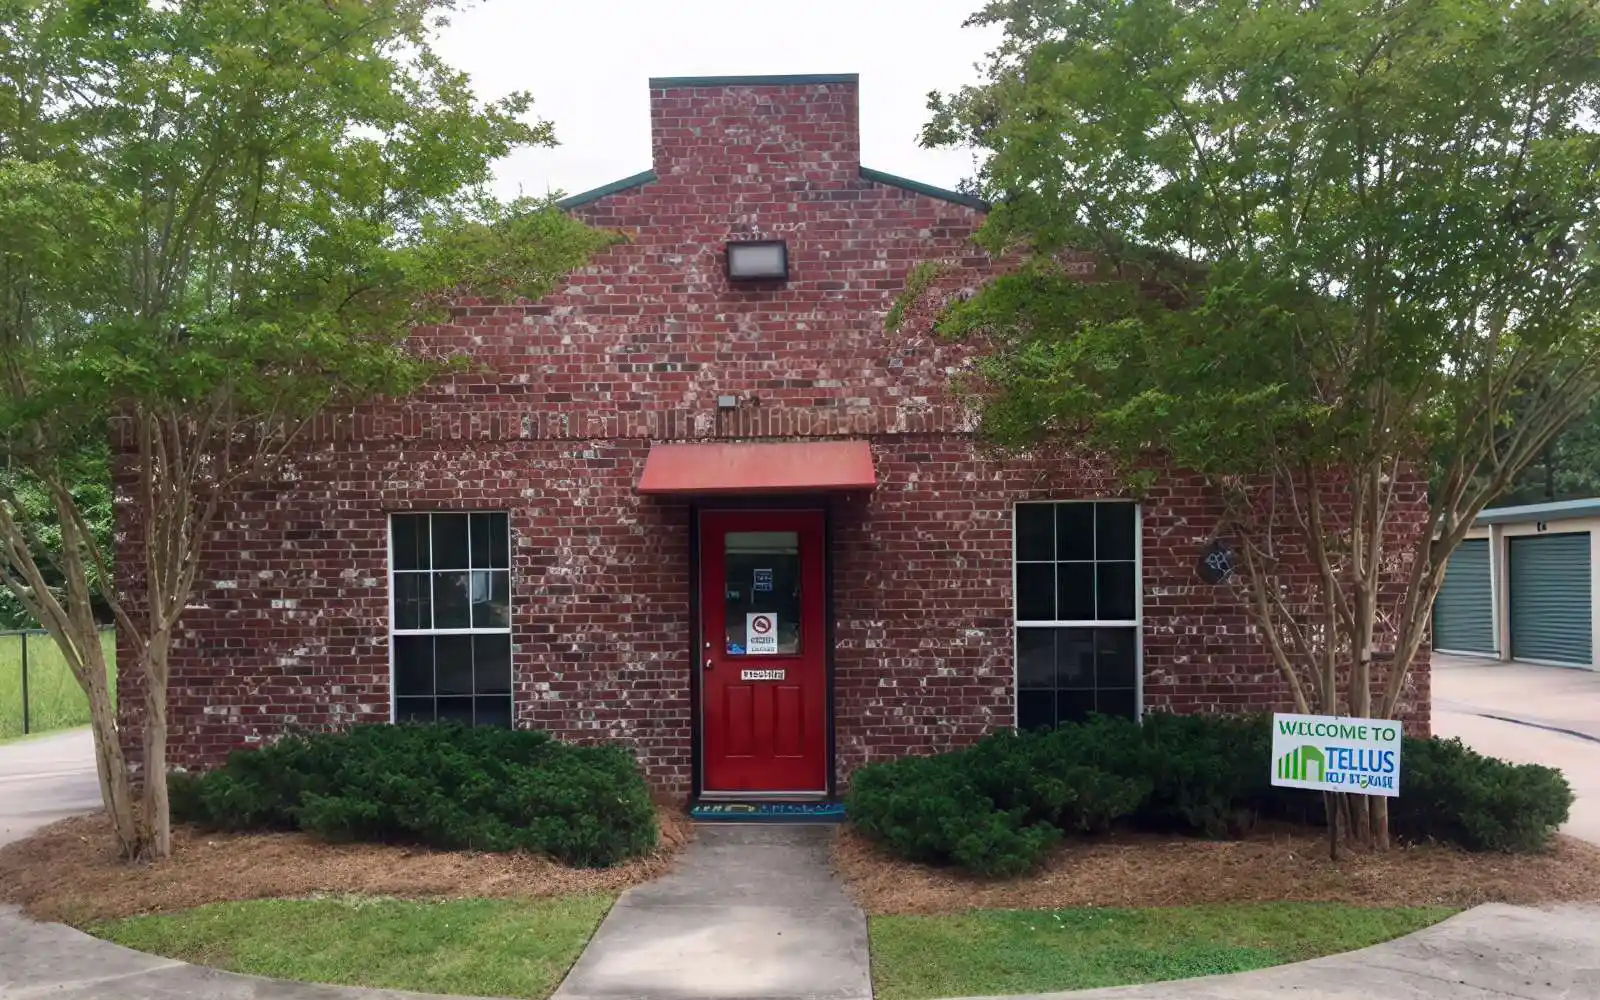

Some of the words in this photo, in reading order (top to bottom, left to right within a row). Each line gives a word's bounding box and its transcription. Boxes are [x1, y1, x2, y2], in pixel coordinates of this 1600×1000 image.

[1279, 720, 1368, 740] WELCOME
[1372, 727, 1396, 741] TO
[1325, 747, 1394, 773] TELLUS
